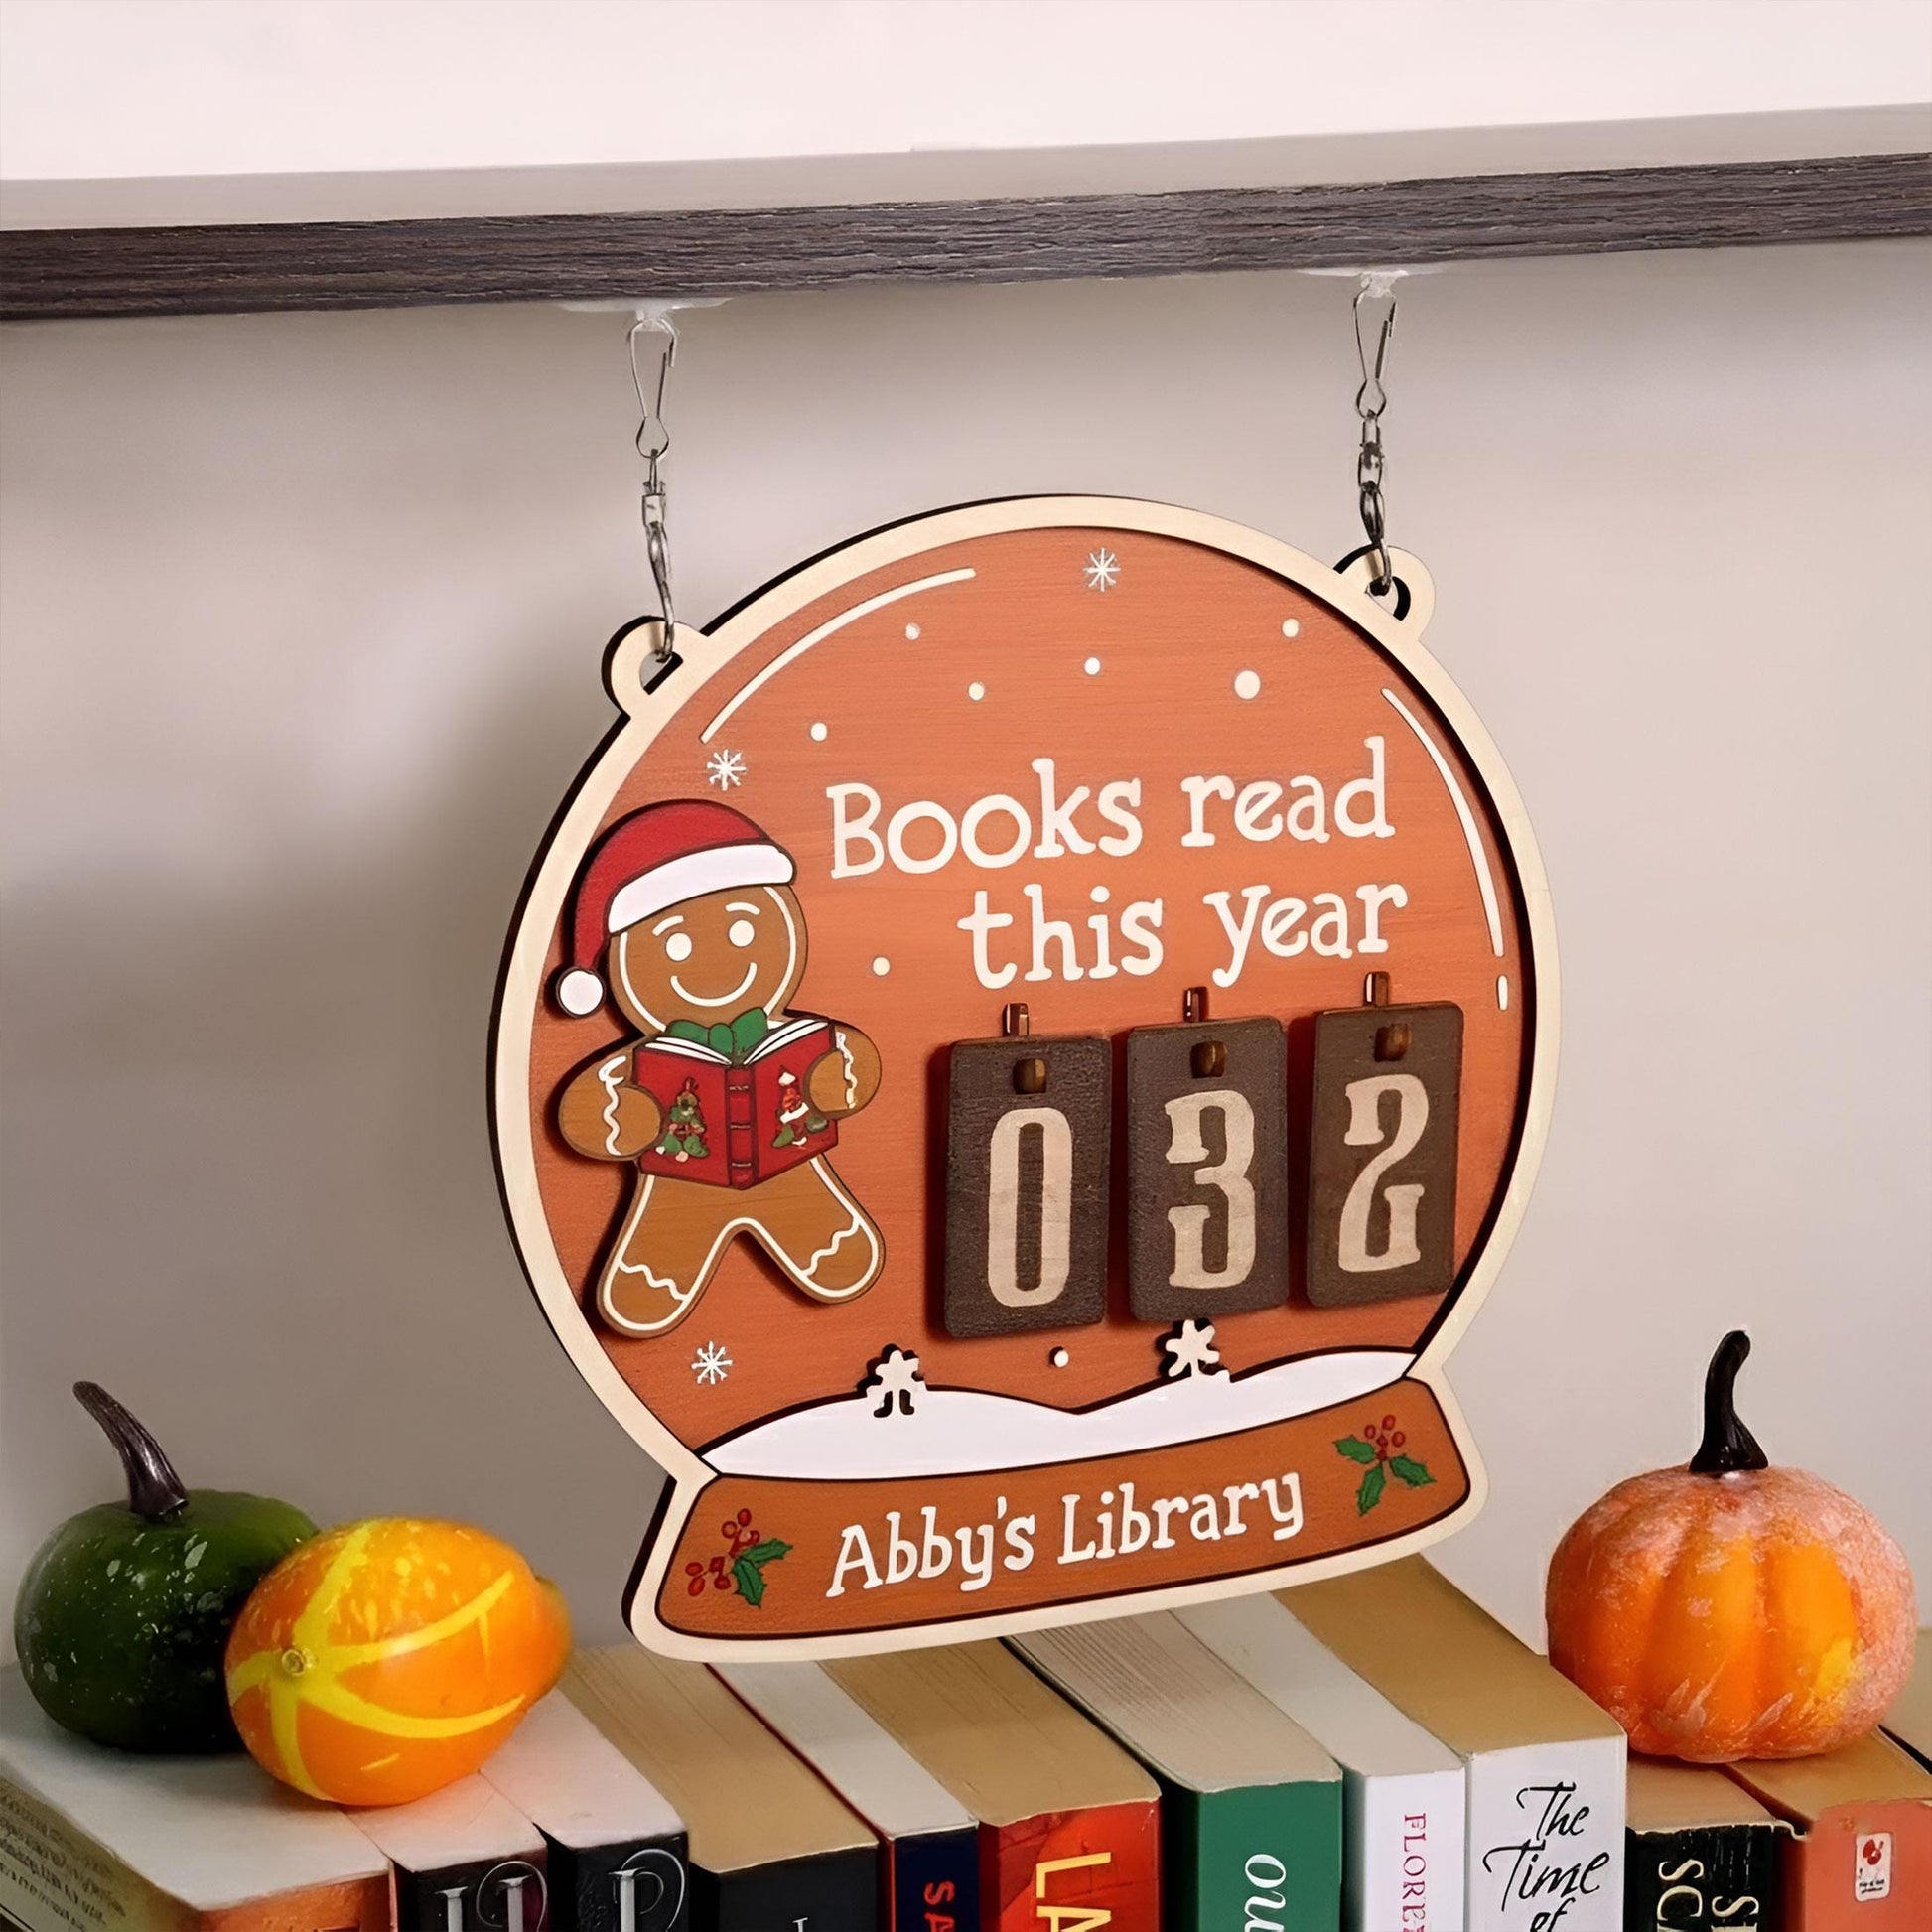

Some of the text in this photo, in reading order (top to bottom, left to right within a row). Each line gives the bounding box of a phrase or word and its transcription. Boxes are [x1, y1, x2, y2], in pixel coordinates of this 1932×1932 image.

[825, 735, 1396, 879] Books read
[957, 883, 1409, 989] this year
[826, 1471, 1306, 1598] Abby's Library
[1516, 1781, 1590, 1841] The
[1482, 1839, 1610, 1912] Time
